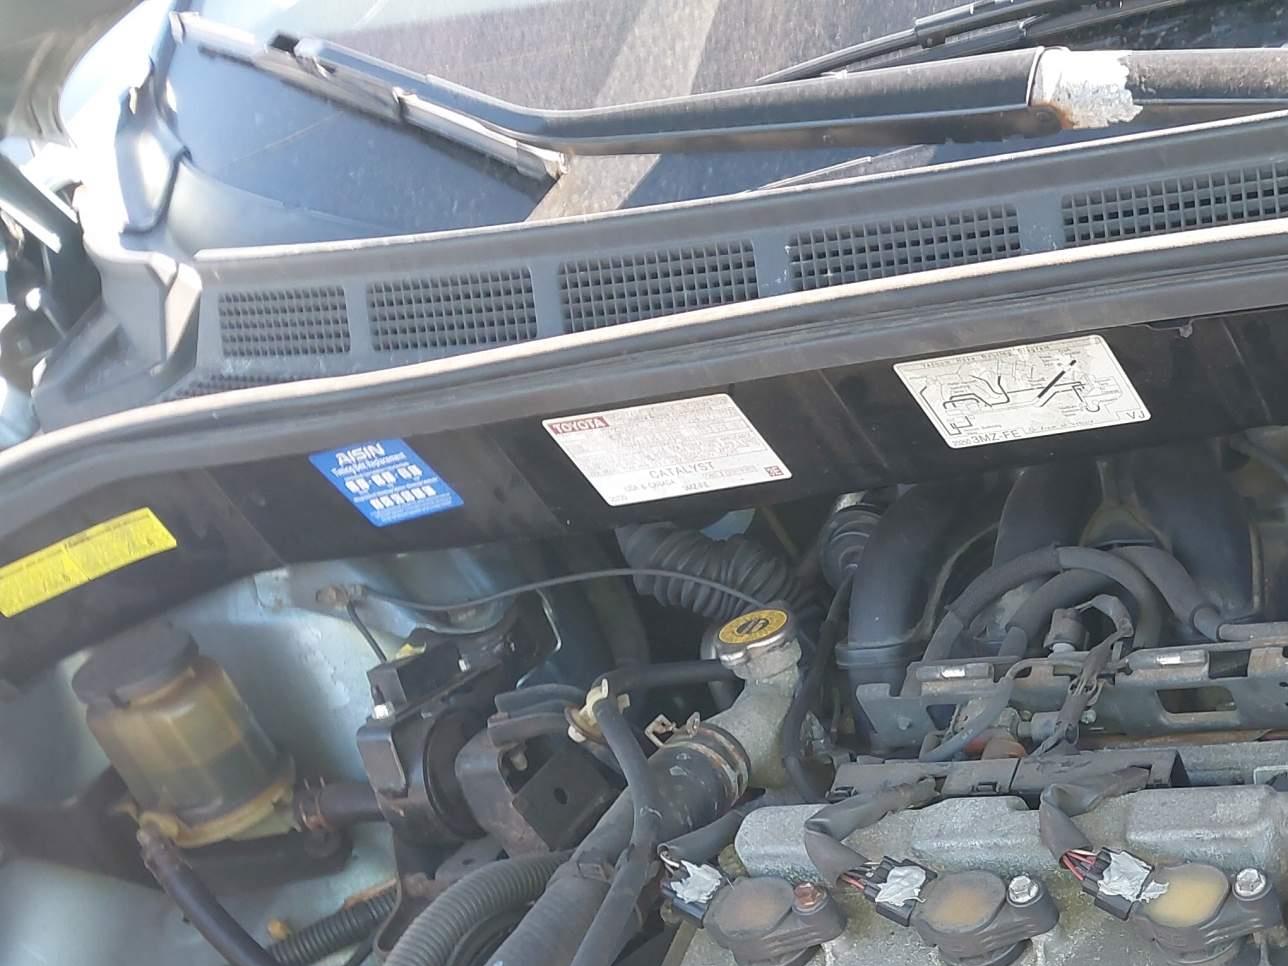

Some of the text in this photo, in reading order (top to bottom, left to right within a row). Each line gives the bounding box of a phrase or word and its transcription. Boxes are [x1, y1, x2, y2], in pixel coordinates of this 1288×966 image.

[1126, 410, 1146, 420] VJ
[552, 417, 606, 438] TOYOTA
[972, 429, 1020, 445] 3MZ-FE
[335, 443, 385, 466] AISIN
[648, 461, 715, 480] CATALYST
